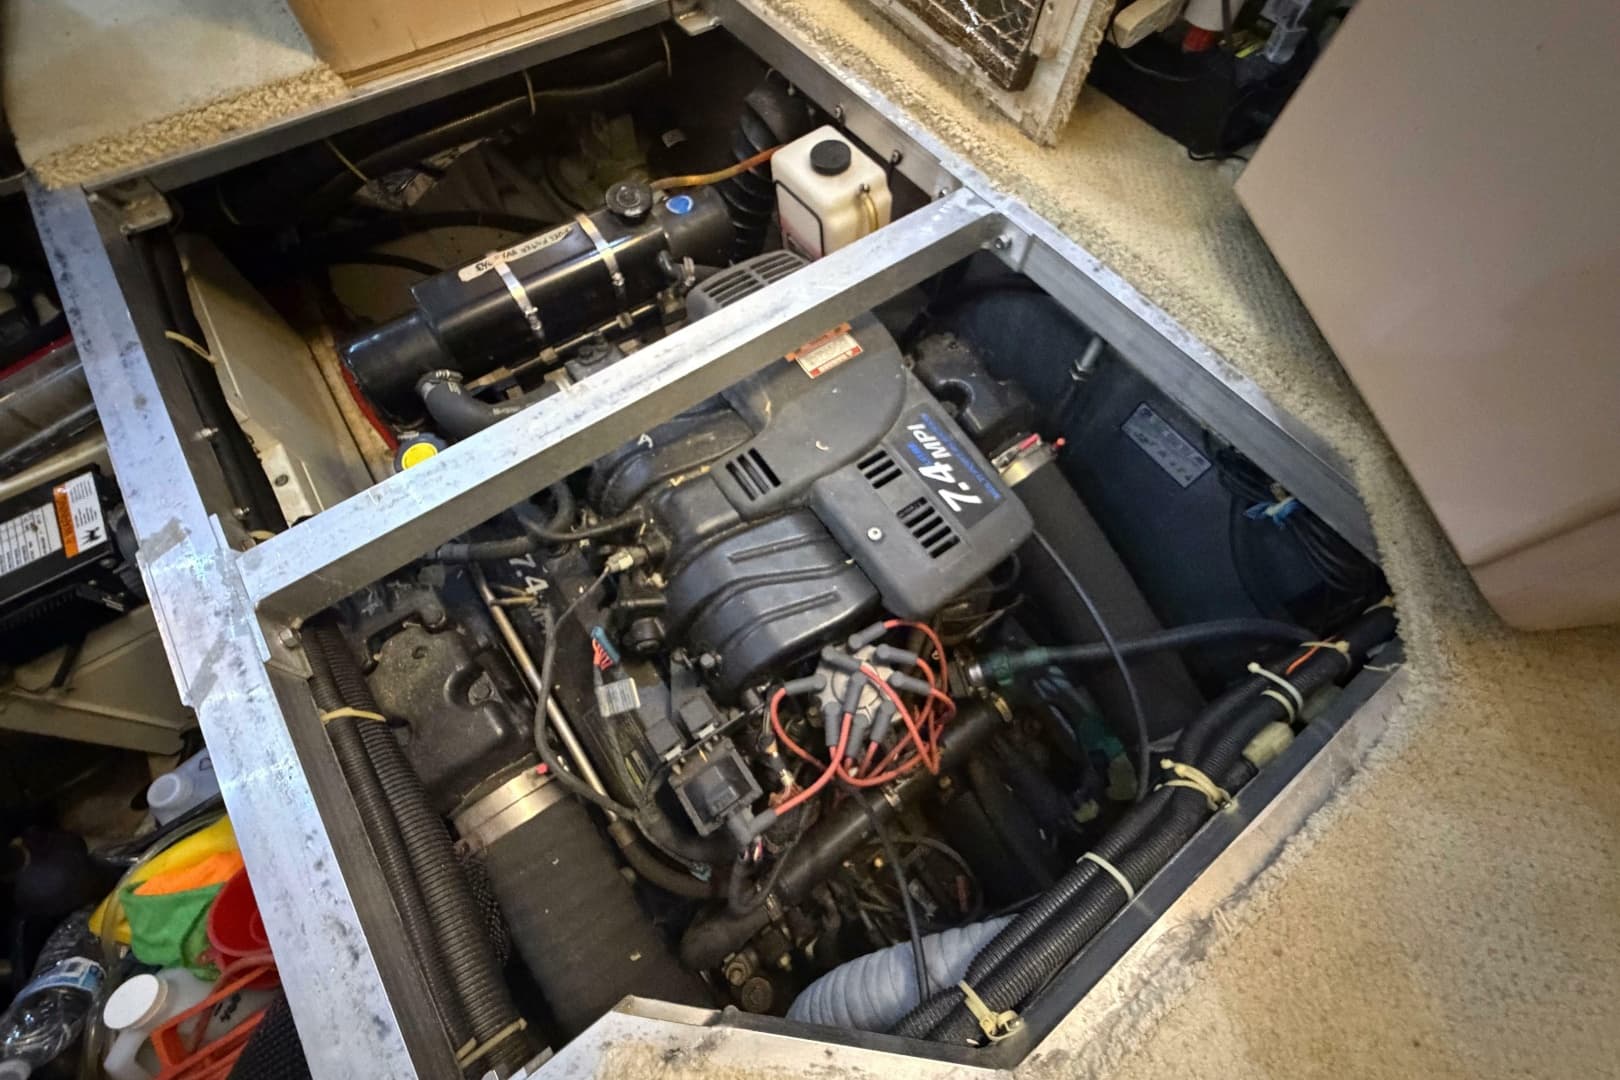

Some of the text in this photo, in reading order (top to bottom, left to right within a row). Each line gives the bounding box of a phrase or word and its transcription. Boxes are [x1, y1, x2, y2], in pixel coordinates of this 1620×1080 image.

[907, 424, 952, 459] MPI
[918, 462, 982, 512] 7.4
[508, 553, 549, 595] 7.4
